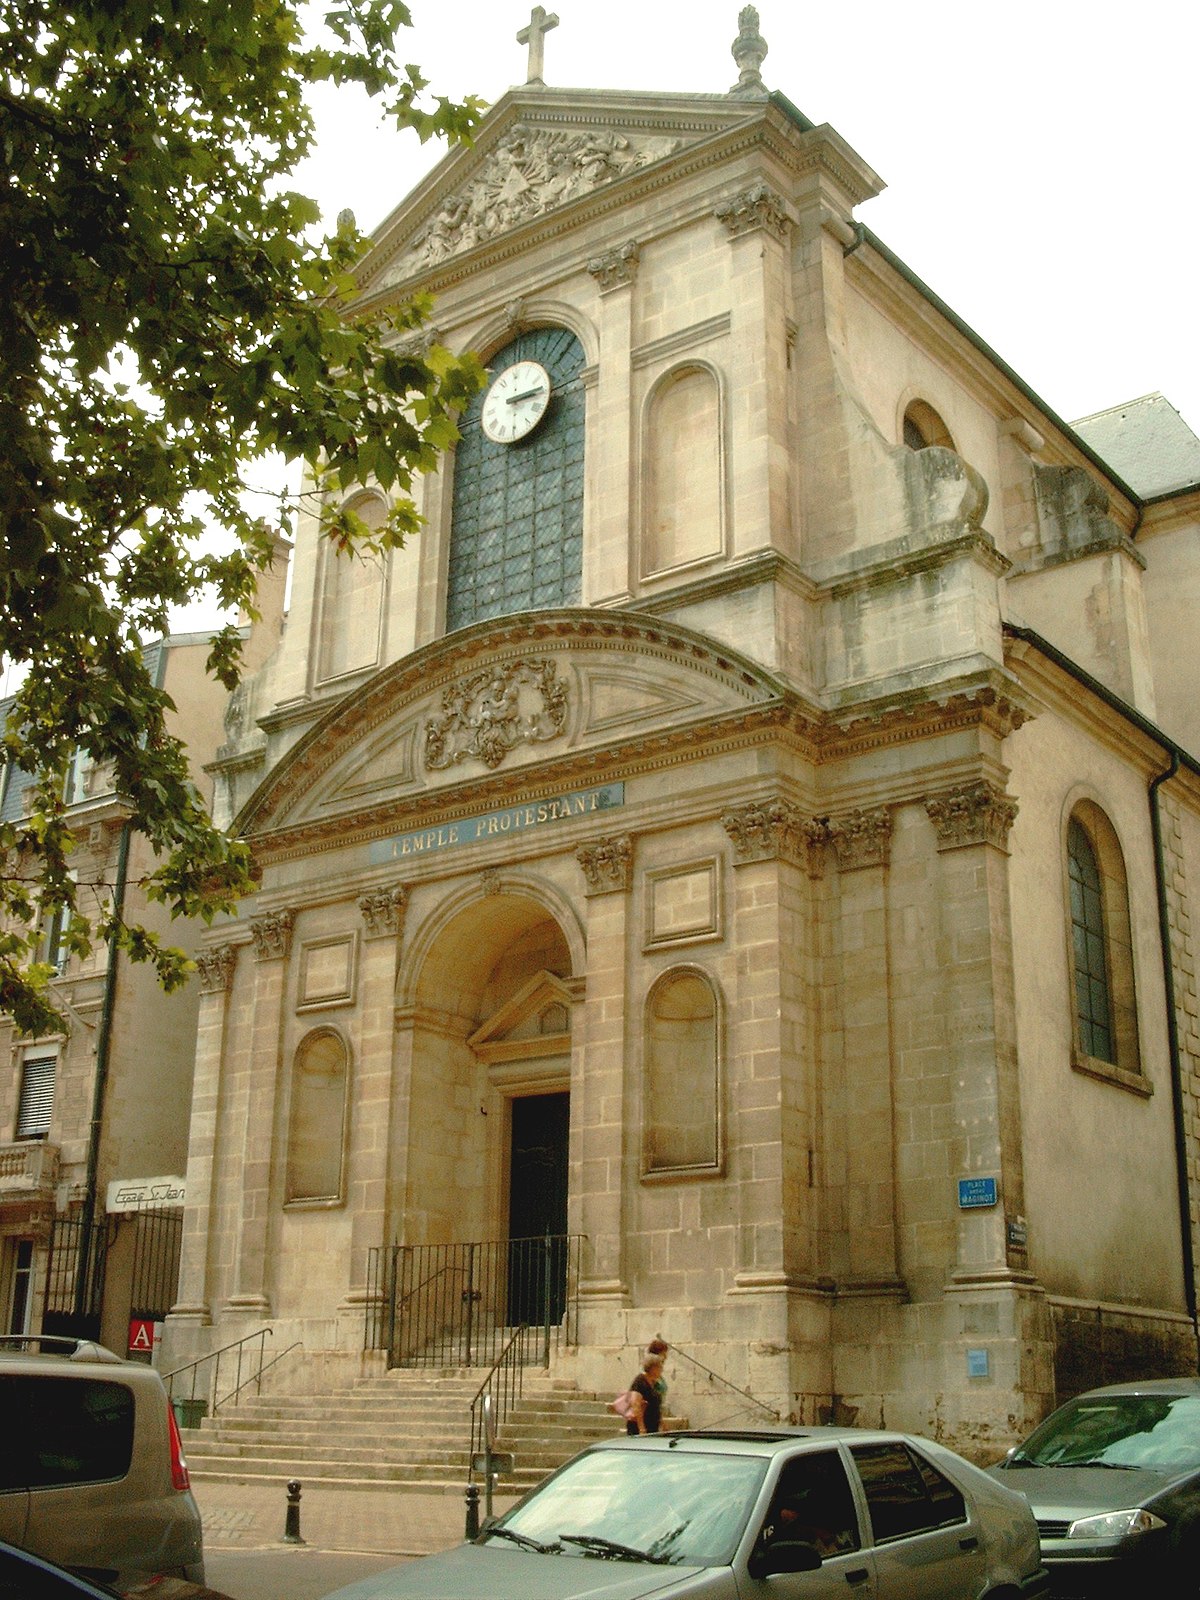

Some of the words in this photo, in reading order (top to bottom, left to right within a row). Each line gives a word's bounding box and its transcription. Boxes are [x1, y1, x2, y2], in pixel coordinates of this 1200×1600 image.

[392, 826, 459, 856] TEMPLE
[476, 793, 599, 837] PROTESTANT
[133, 1324, 150, 1346] A
